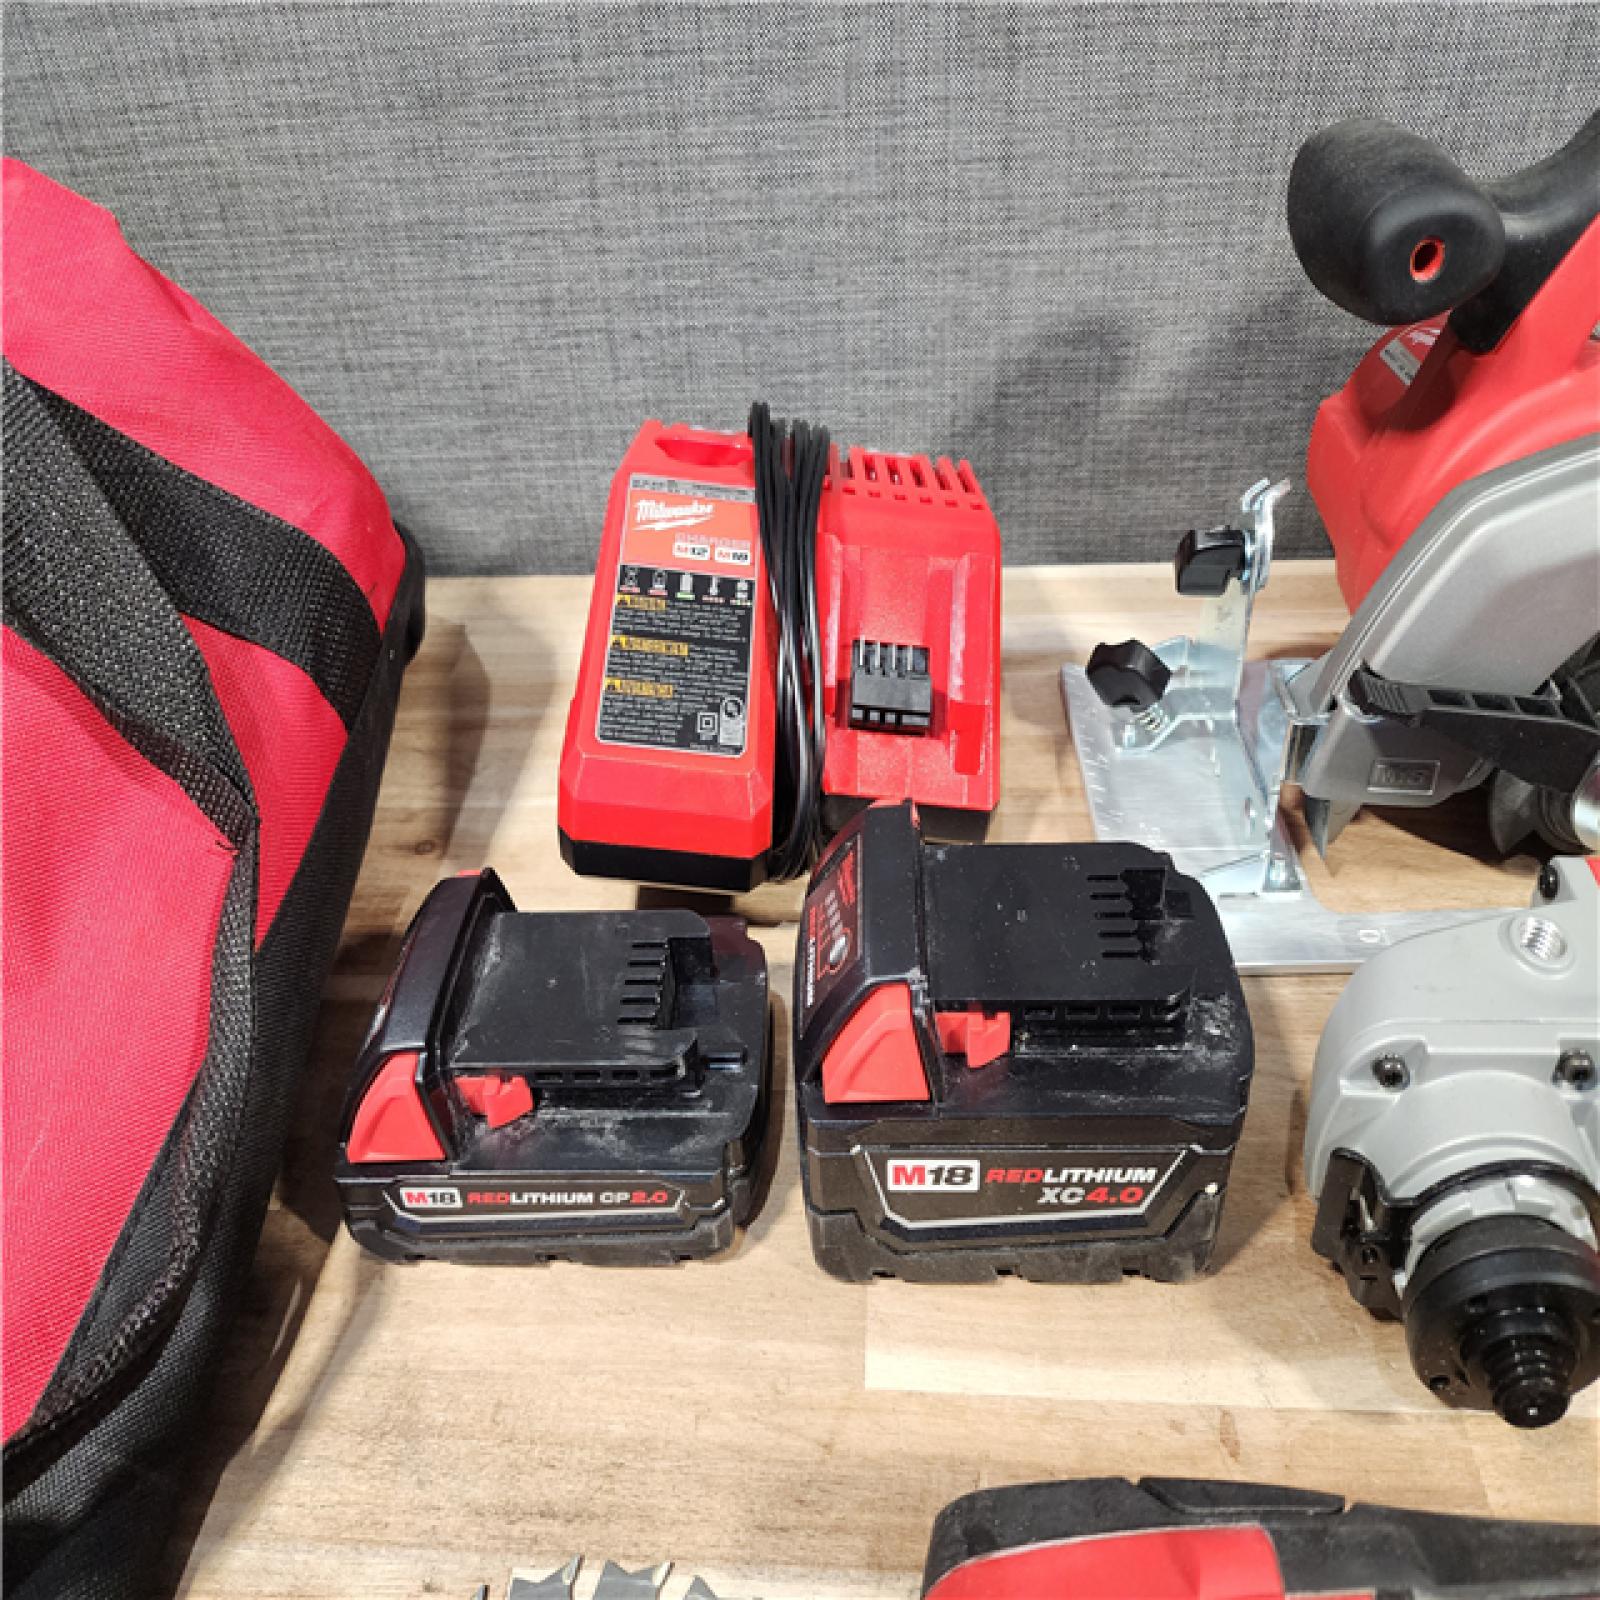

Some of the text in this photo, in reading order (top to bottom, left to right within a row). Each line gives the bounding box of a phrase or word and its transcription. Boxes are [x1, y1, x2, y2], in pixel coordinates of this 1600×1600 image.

[888, 1164, 1158, 1187] M18 REDLITHIUM
[404, 1191, 459, 1206] M18
[466, 1191, 593, 1204] REDLITHIUM
